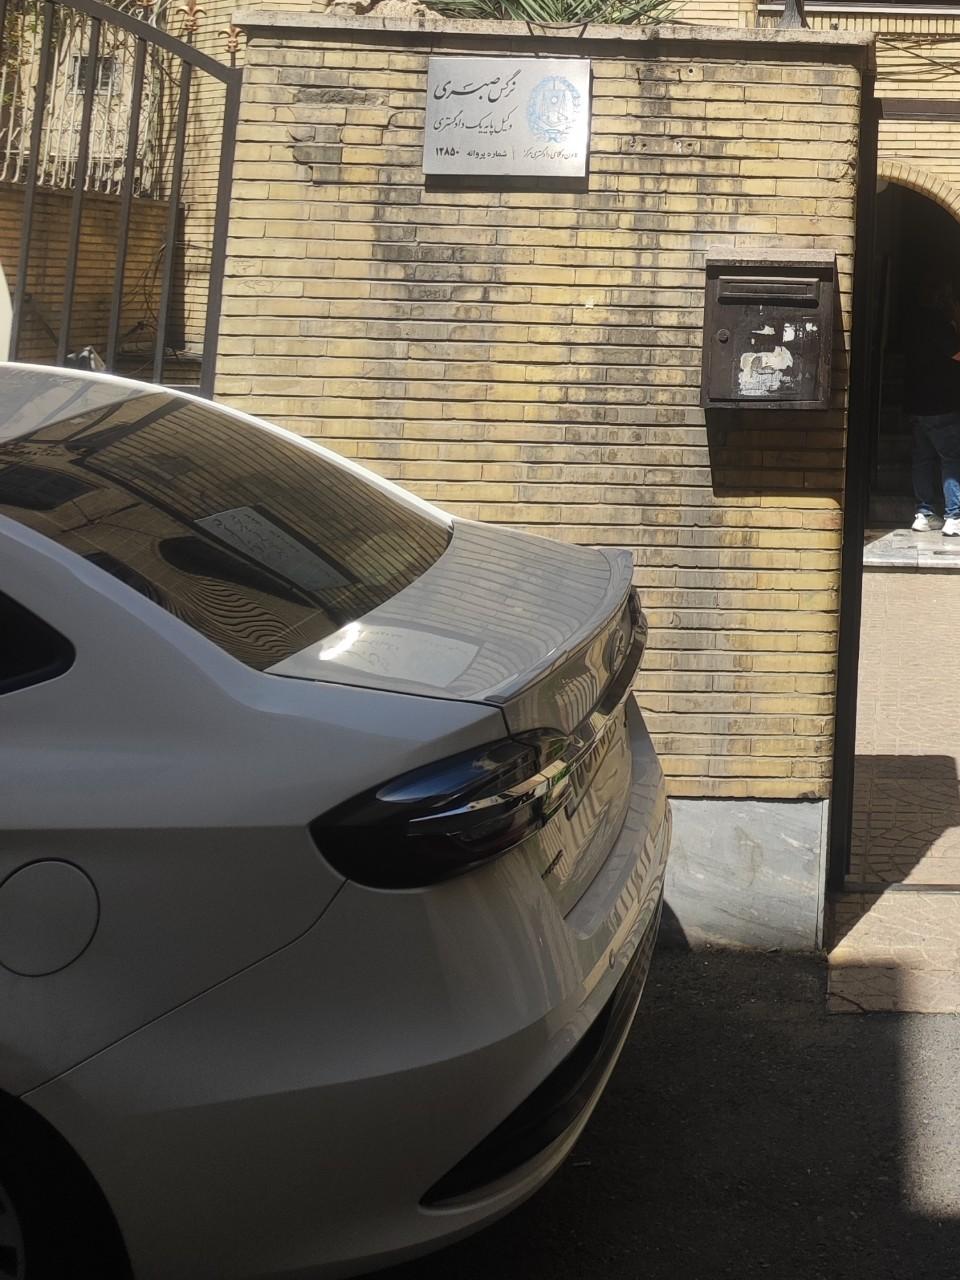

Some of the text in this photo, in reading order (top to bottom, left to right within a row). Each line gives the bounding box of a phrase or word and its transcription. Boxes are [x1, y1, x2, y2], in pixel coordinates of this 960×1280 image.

[433, 69, 521, 103] نرگس صبری
[433, 110, 465, 132] دادگستری
[494, 105, 519, 133] وکیل
[466, 149, 487, 160] پروانه
